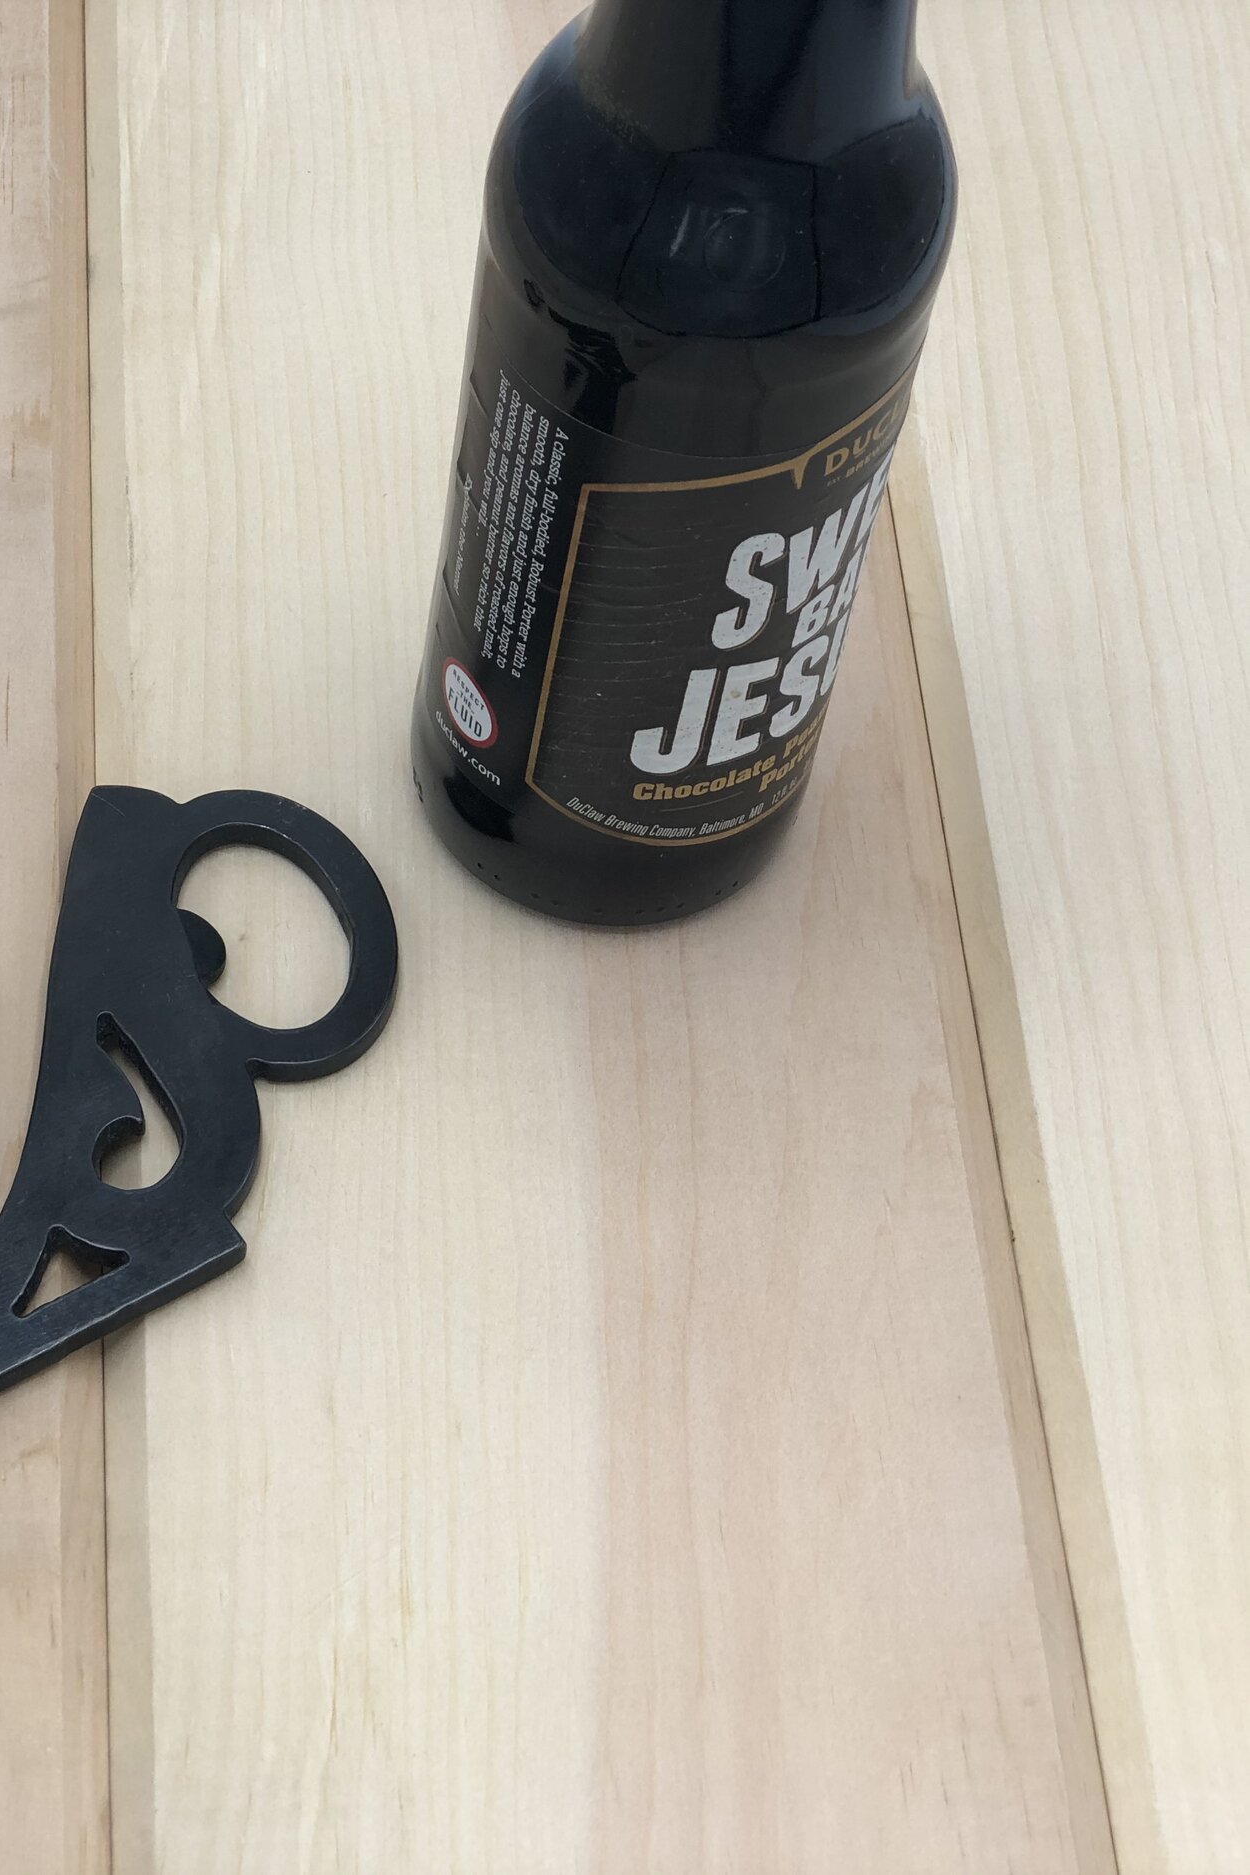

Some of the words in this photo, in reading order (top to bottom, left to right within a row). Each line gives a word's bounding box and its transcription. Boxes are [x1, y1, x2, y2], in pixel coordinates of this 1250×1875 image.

[498, 368, 512, 403] just
[494, 401, 505, 428] one
[501, 389, 522, 452] chocolate,
[518, 403, 537, 455] balance
[555, 427, 570, 440] A
[489, 425, 501, 448] sip
[531, 416, 549, 466] smooth,
[485, 446, 497, 477] and
[498, 454, 510, 482] and
[510, 454, 525, 503] aromas
[545, 441, 566, 485] classic,
[482, 469, 494, 500] you
[491, 475, 505, 526] peanut
[525, 469, 541, 495] dry
[505, 501, 517, 529] and
[521, 493, 538, 532] finish
[531, 486, 559, 557] full-bodied,
[485, 523, 499, 565] butter
[498, 526, 515, 572] flavors
[516, 531, 529, 559] and
[711, 442, 896, 650] SWE
[482, 562, 491, 580] so
[495, 570, 506, 590] of
[511, 550, 526, 582] just
[525, 558, 544, 603] Robust
[477, 578, 489, 606] rich
[487, 586, 504, 634] roasted
[501, 580, 521, 626] enough
[791, 546, 865, 648] BA
[473, 604, 485, 632] that
[518, 600, 536, 641] Porter
[481, 631, 494, 659] malt,
[496, 627, 514, 656] hops
[513, 641, 528, 669] with
[496, 656, 507, 669] to
[451, 668, 485, 711] RESPECT
[448, 687, 483, 738] FLUID
[435, 710, 501, 787] duclaw.com
[632, 754, 776, 801] Chocolate
[566, 796, 605, 823] DuClaw
[603, 814, 649, 837] Brewing
